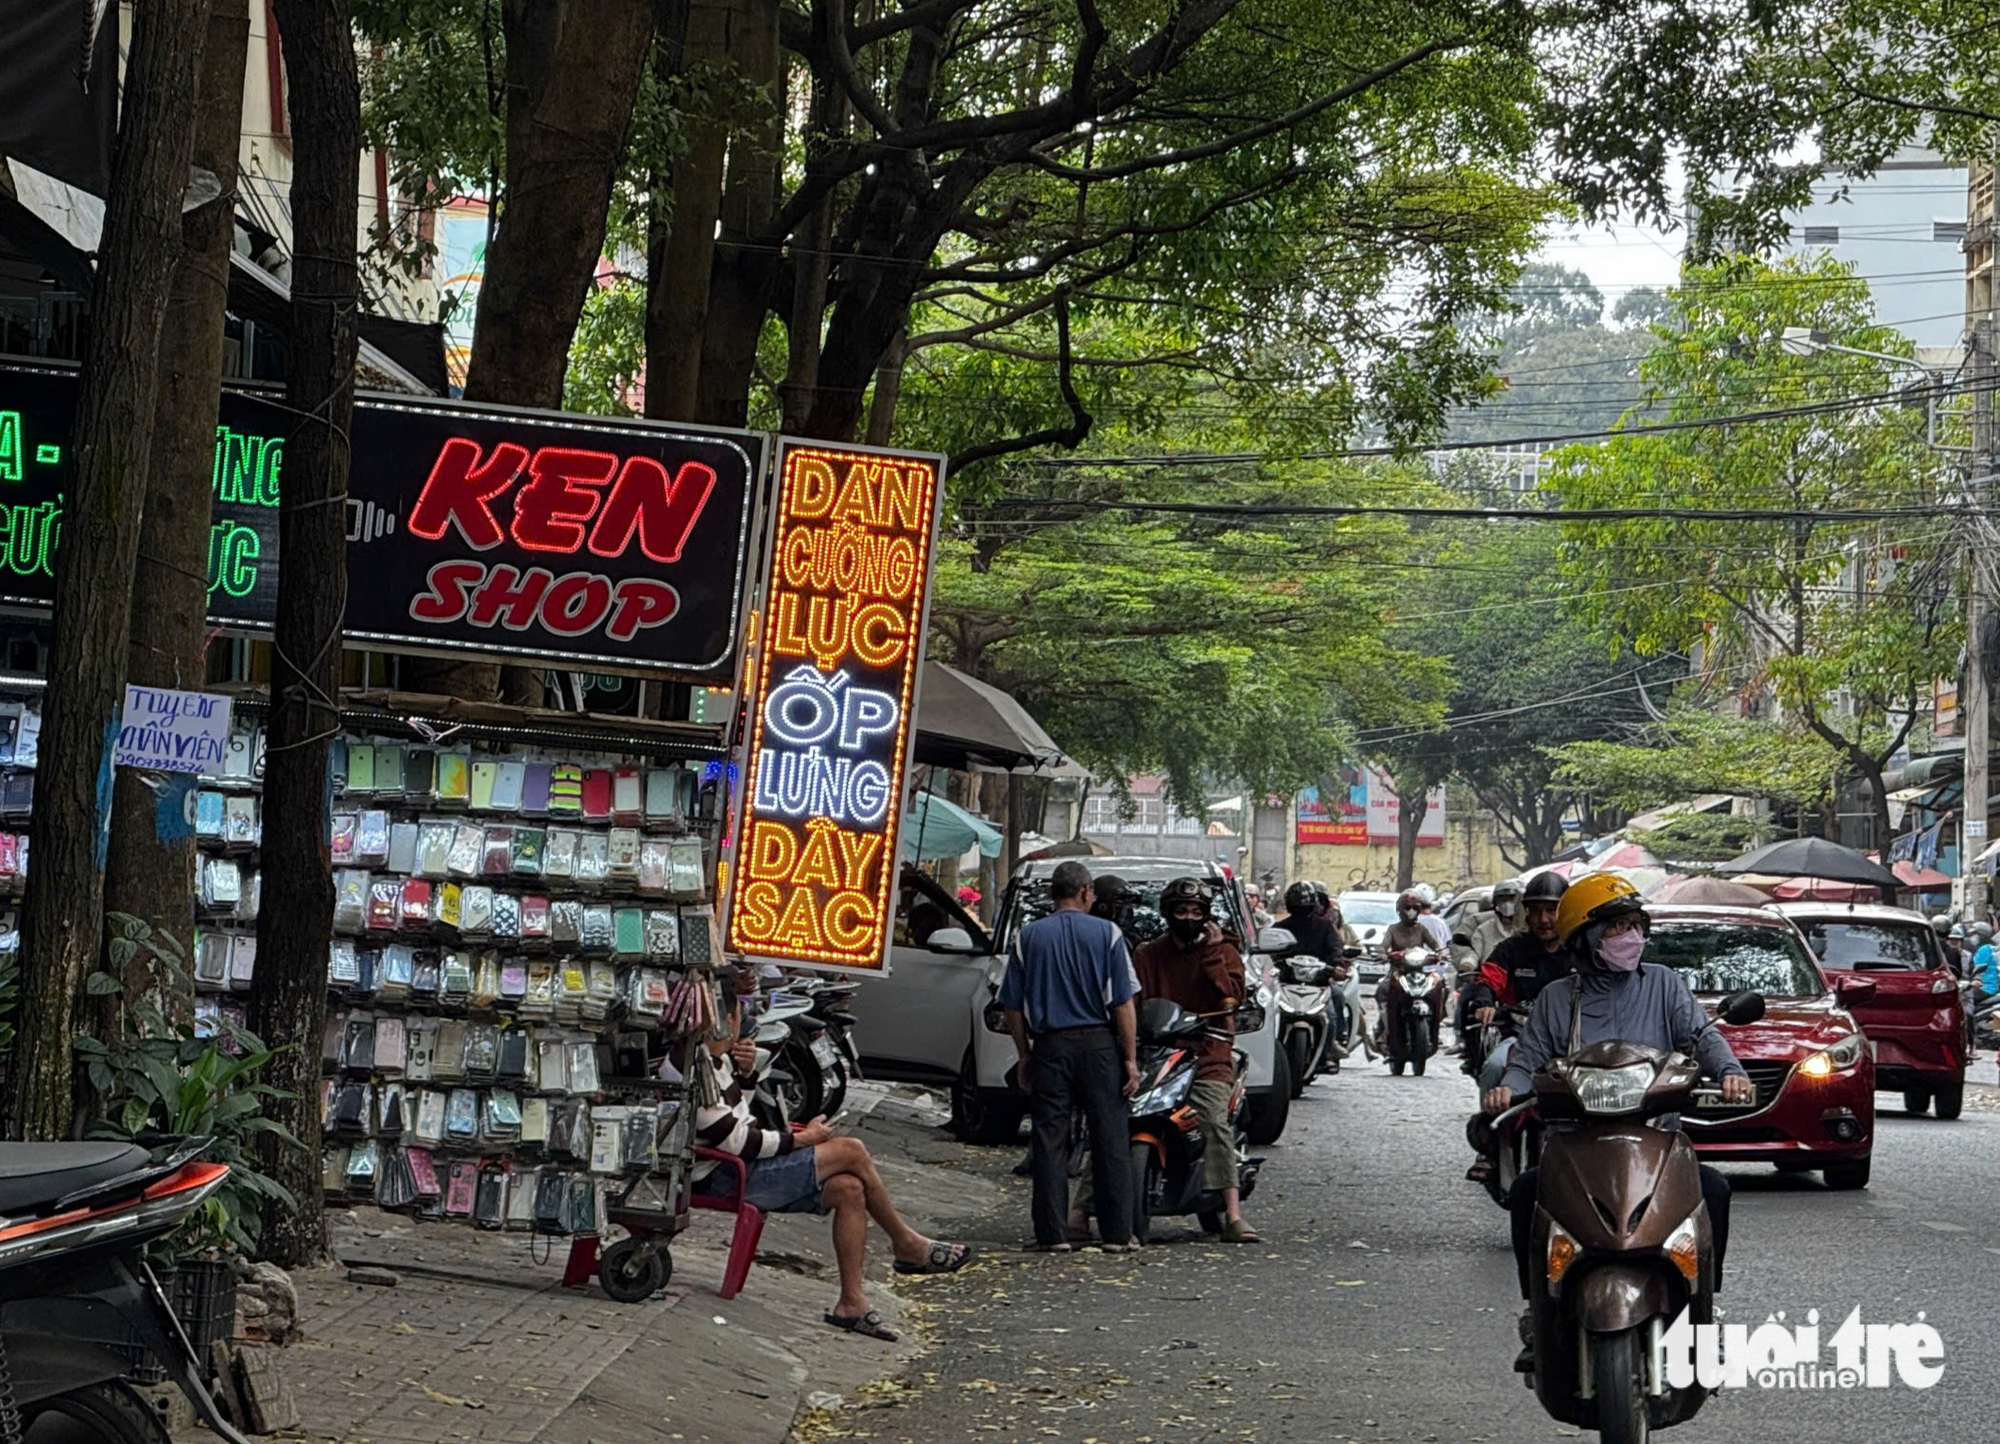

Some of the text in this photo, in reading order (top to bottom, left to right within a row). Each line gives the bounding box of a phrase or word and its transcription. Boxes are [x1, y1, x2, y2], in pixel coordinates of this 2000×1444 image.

[407, 437, 717, 563] KEN
[789, 456, 925, 530] DÁN
[783, 520, 917, 600] CƯỜNG
[409, 559, 681, 642] SHOP
[773, 592, 907, 670] LỰC
[764, 664, 900, 749] ỐP
[175, 729, 225, 765] VIÊN
[752, 746, 891, 823] LƯNG
[749, 816, 882, 890] DÂY
[740, 881, 876, 950] SẠC
